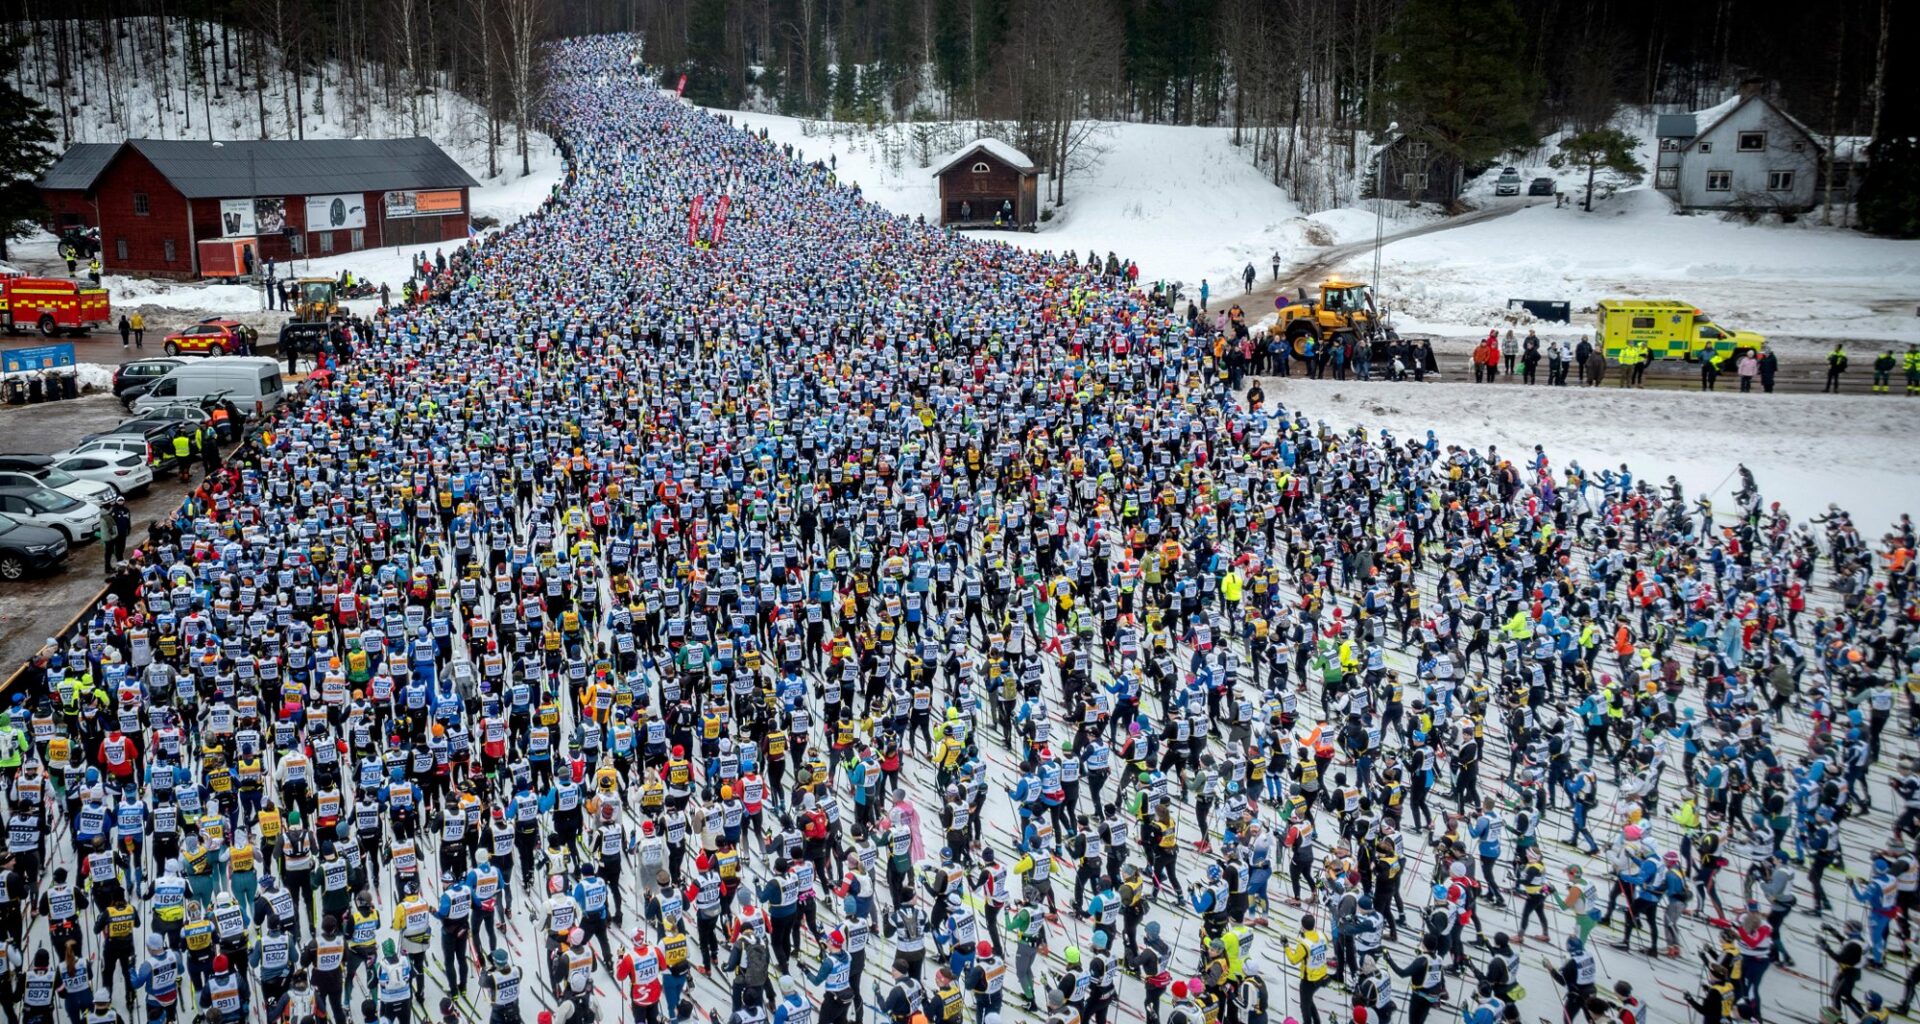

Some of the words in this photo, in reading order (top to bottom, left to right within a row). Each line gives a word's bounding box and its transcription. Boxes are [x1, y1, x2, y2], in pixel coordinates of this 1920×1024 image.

[122, 817, 140, 825] 1596
[446, 826, 462, 834] 7415
[11, 833, 32, 841] 1942
[94, 867, 112, 875] 6375
[160, 895, 181, 904] 1646
[53, 903, 72, 912] 6652
[408, 915, 426, 923] 9024
[555, 916, 571, 925] 7537
[112, 923, 131, 932] 6094
[266, 952, 285, 960] 6302
[669, 949, 684, 958] 7042
[321, 955, 339, 963] 6694
[640, 967, 655, 977] 7441
[156, 971, 175, 983] 7977
[28, 990, 49, 998] 6979
[500, 987, 518, 996] 7593
[217, 998, 236, 1008] 9911
